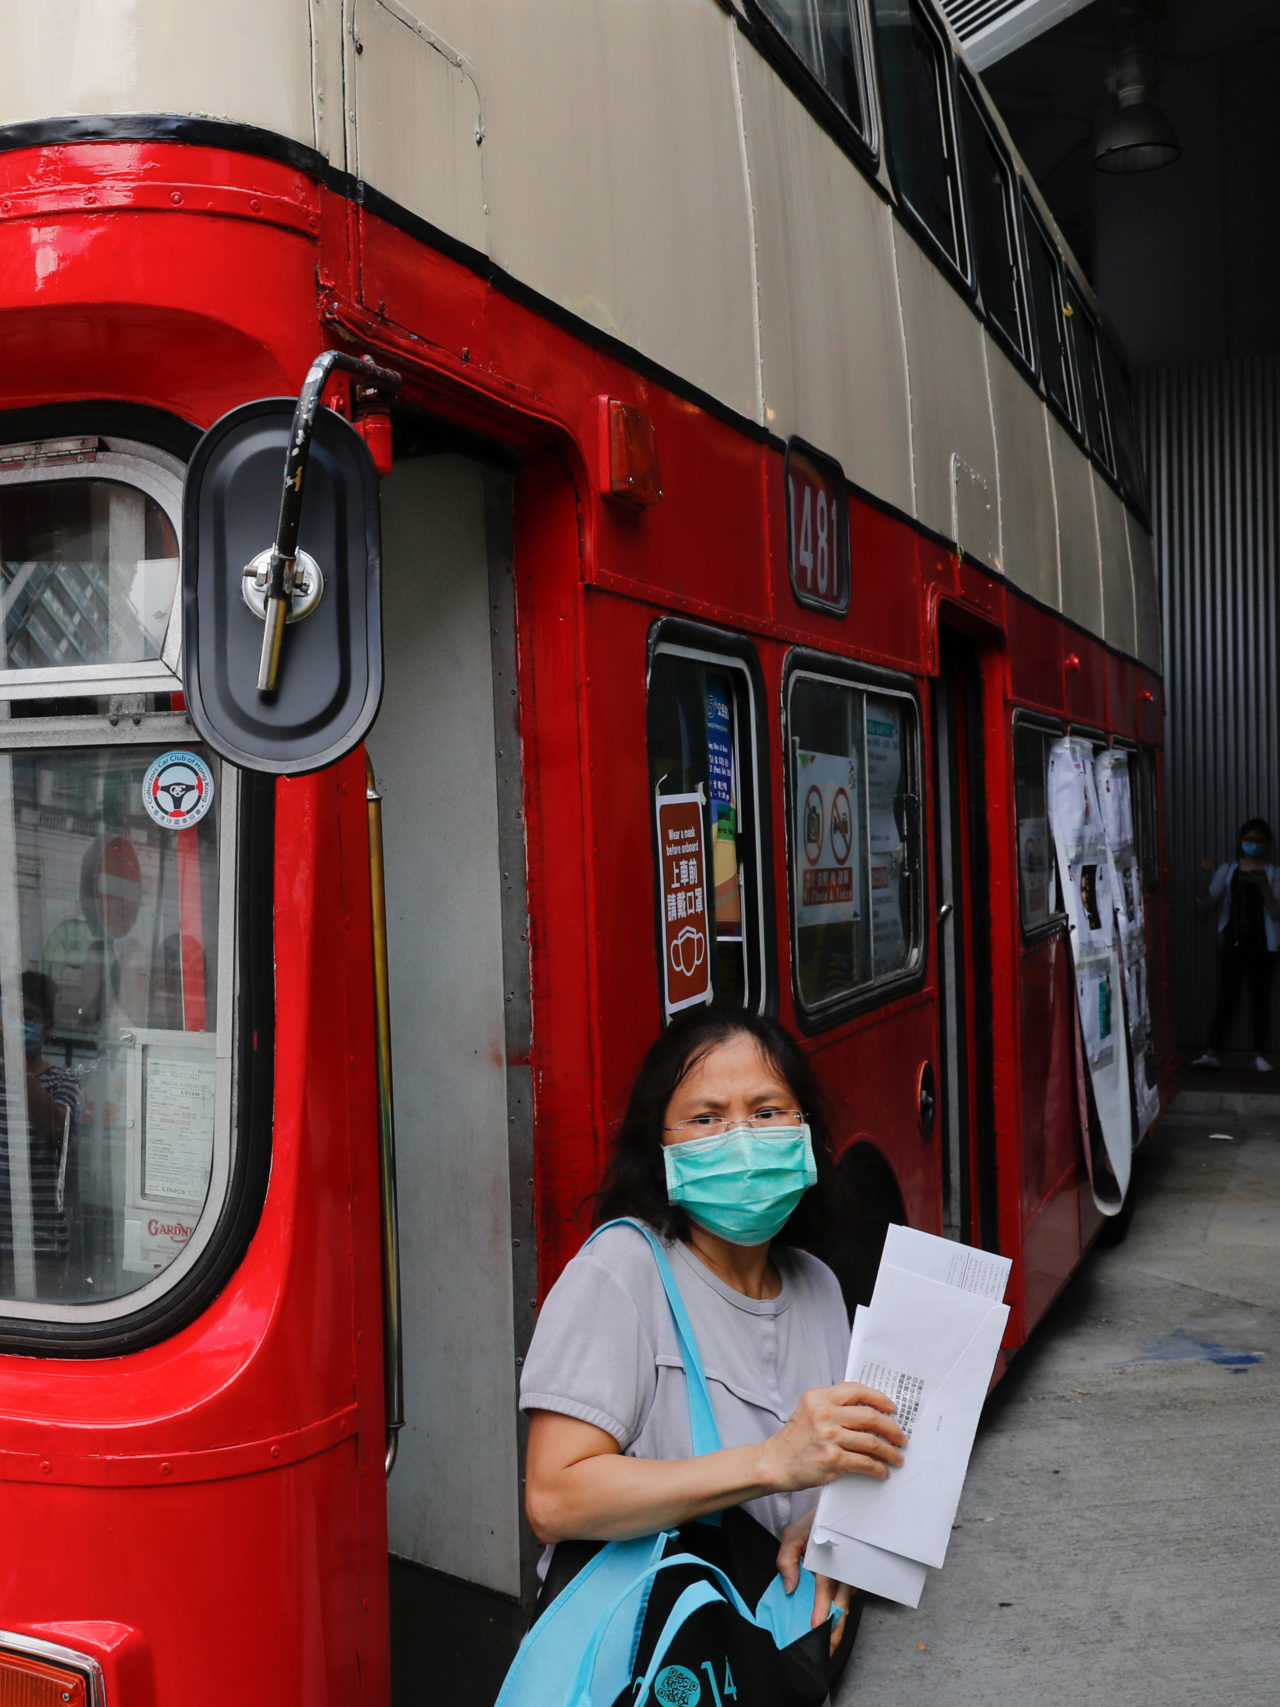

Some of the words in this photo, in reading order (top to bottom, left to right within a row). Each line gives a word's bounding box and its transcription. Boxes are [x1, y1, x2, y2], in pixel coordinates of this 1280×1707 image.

[146, 768, 158, 804] Collectors
[157, 758, 169, 768] Car
[169, 754, 187, 762] Club
[194, 762, 208, 782] Hong
[202, 782, 210, 803] Kong
[666, 843, 681, 856] before
[682, 840, 699, 853] onboard
[668, 829, 680, 840] Wear
[684, 826, 696, 838] mask
[671, 858, 697, 888] 上車前
[667, 887, 703, 922] 請戴口罩
